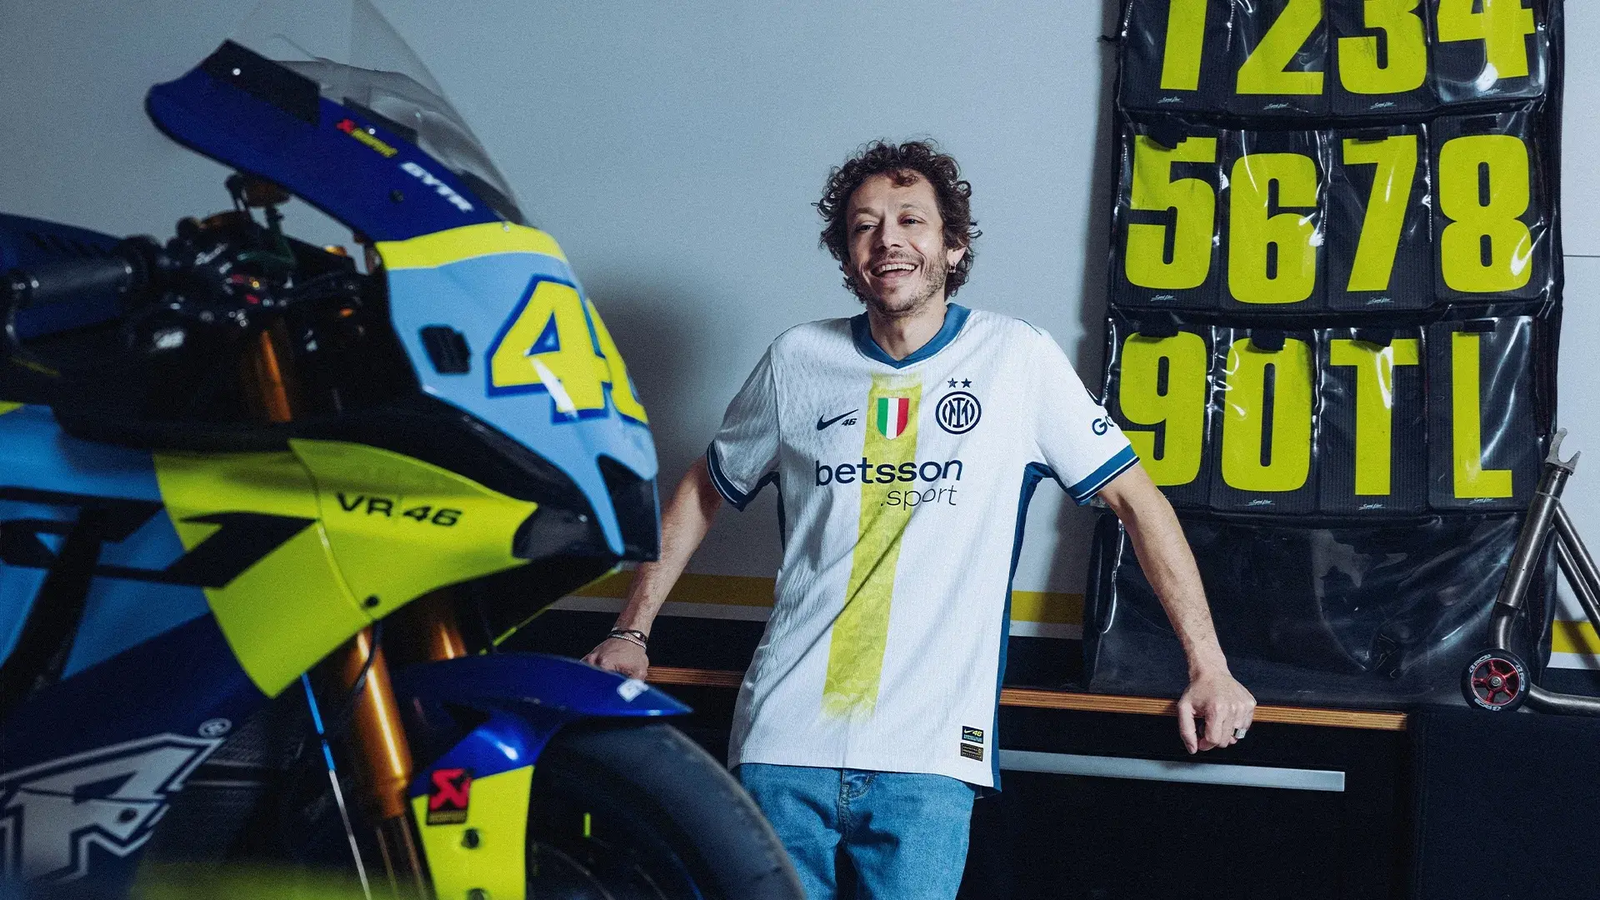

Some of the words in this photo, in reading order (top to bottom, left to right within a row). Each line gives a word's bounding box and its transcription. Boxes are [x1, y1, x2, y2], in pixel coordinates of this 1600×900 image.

[1160, 0, 1208, 91] 1
[1236, 0, 1326, 95] 2
[1337, 0, 1428, 95] 3
[1125, 136, 1217, 290] 5
[1227, 152, 1318, 306] 6
[1342, 134, 1419, 292] 7
[1438, 134, 1533, 293] 8
[841, 417, 858, 427] 46
[1118, 331, 1208, 488] 9
[1329, 338, 1420, 496] T
[1451, 330, 1514, 499] L
[815, 457, 963, 487] betsson
[336, 491, 394, 518] VR
[402, 505, 463, 528] 46
[880, 485, 957, 511] .sport
